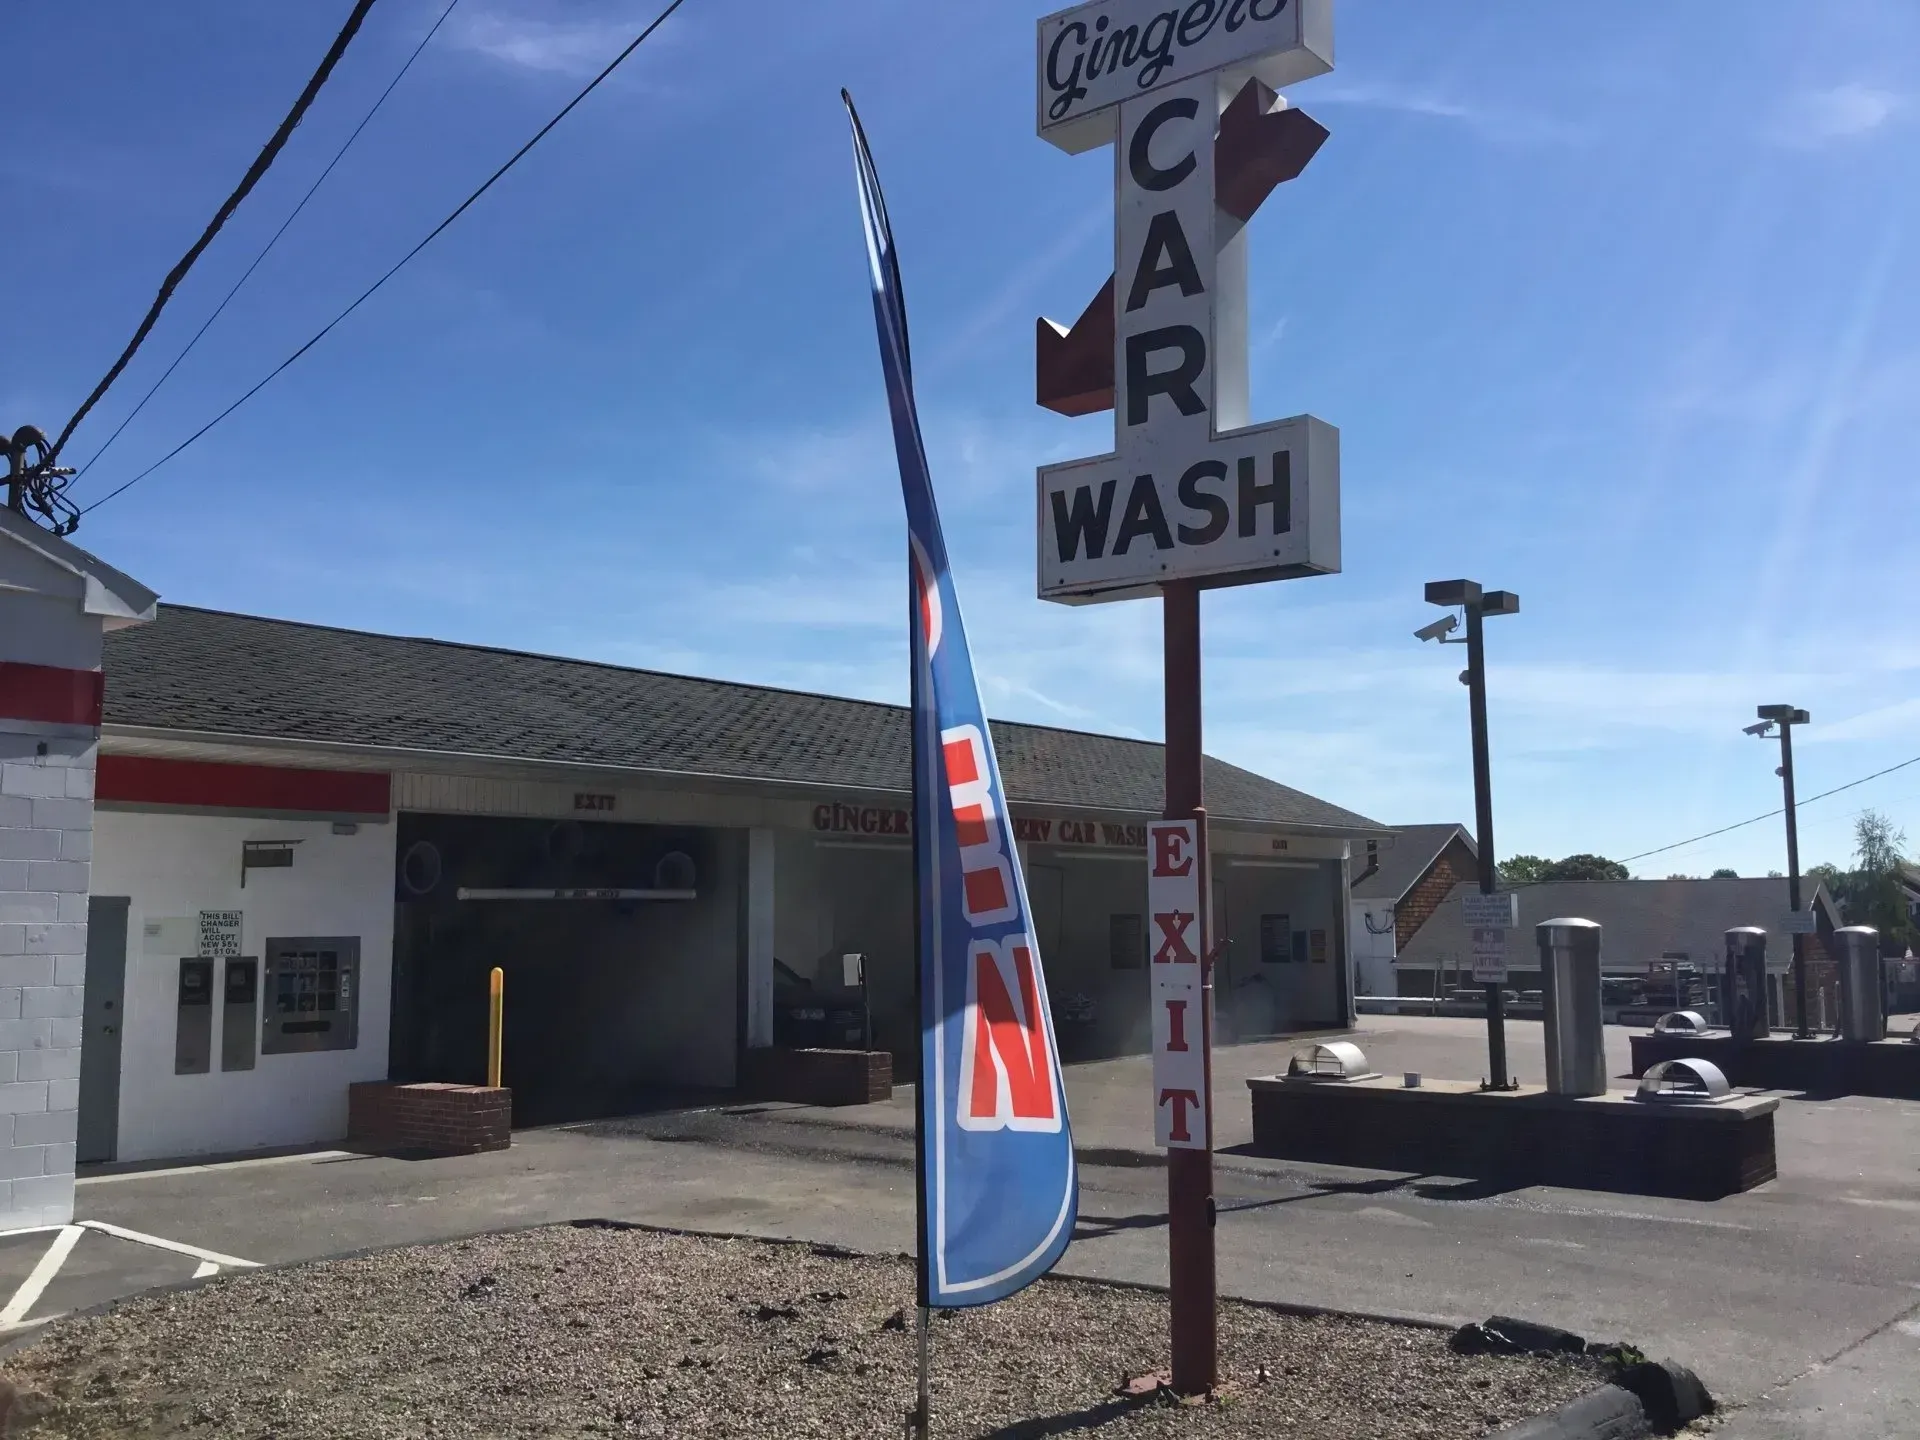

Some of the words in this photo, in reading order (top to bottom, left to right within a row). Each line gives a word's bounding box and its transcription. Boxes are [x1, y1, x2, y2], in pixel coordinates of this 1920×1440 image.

[1125, 97, 1208, 427] CAR
[1050, 450, 1291, 564] WASH
[574, 793, 616, 811] EXIT
[813, 803, 911, 833] GINGER
[1014, 818, 1052, 842] ERV
[1059, 820, 1096, 843] CAR
[202, 912, 220, 920] THIS
[222, 912, 240, 920] BILL
[1151, 826, 1201, 1142] EXIT
